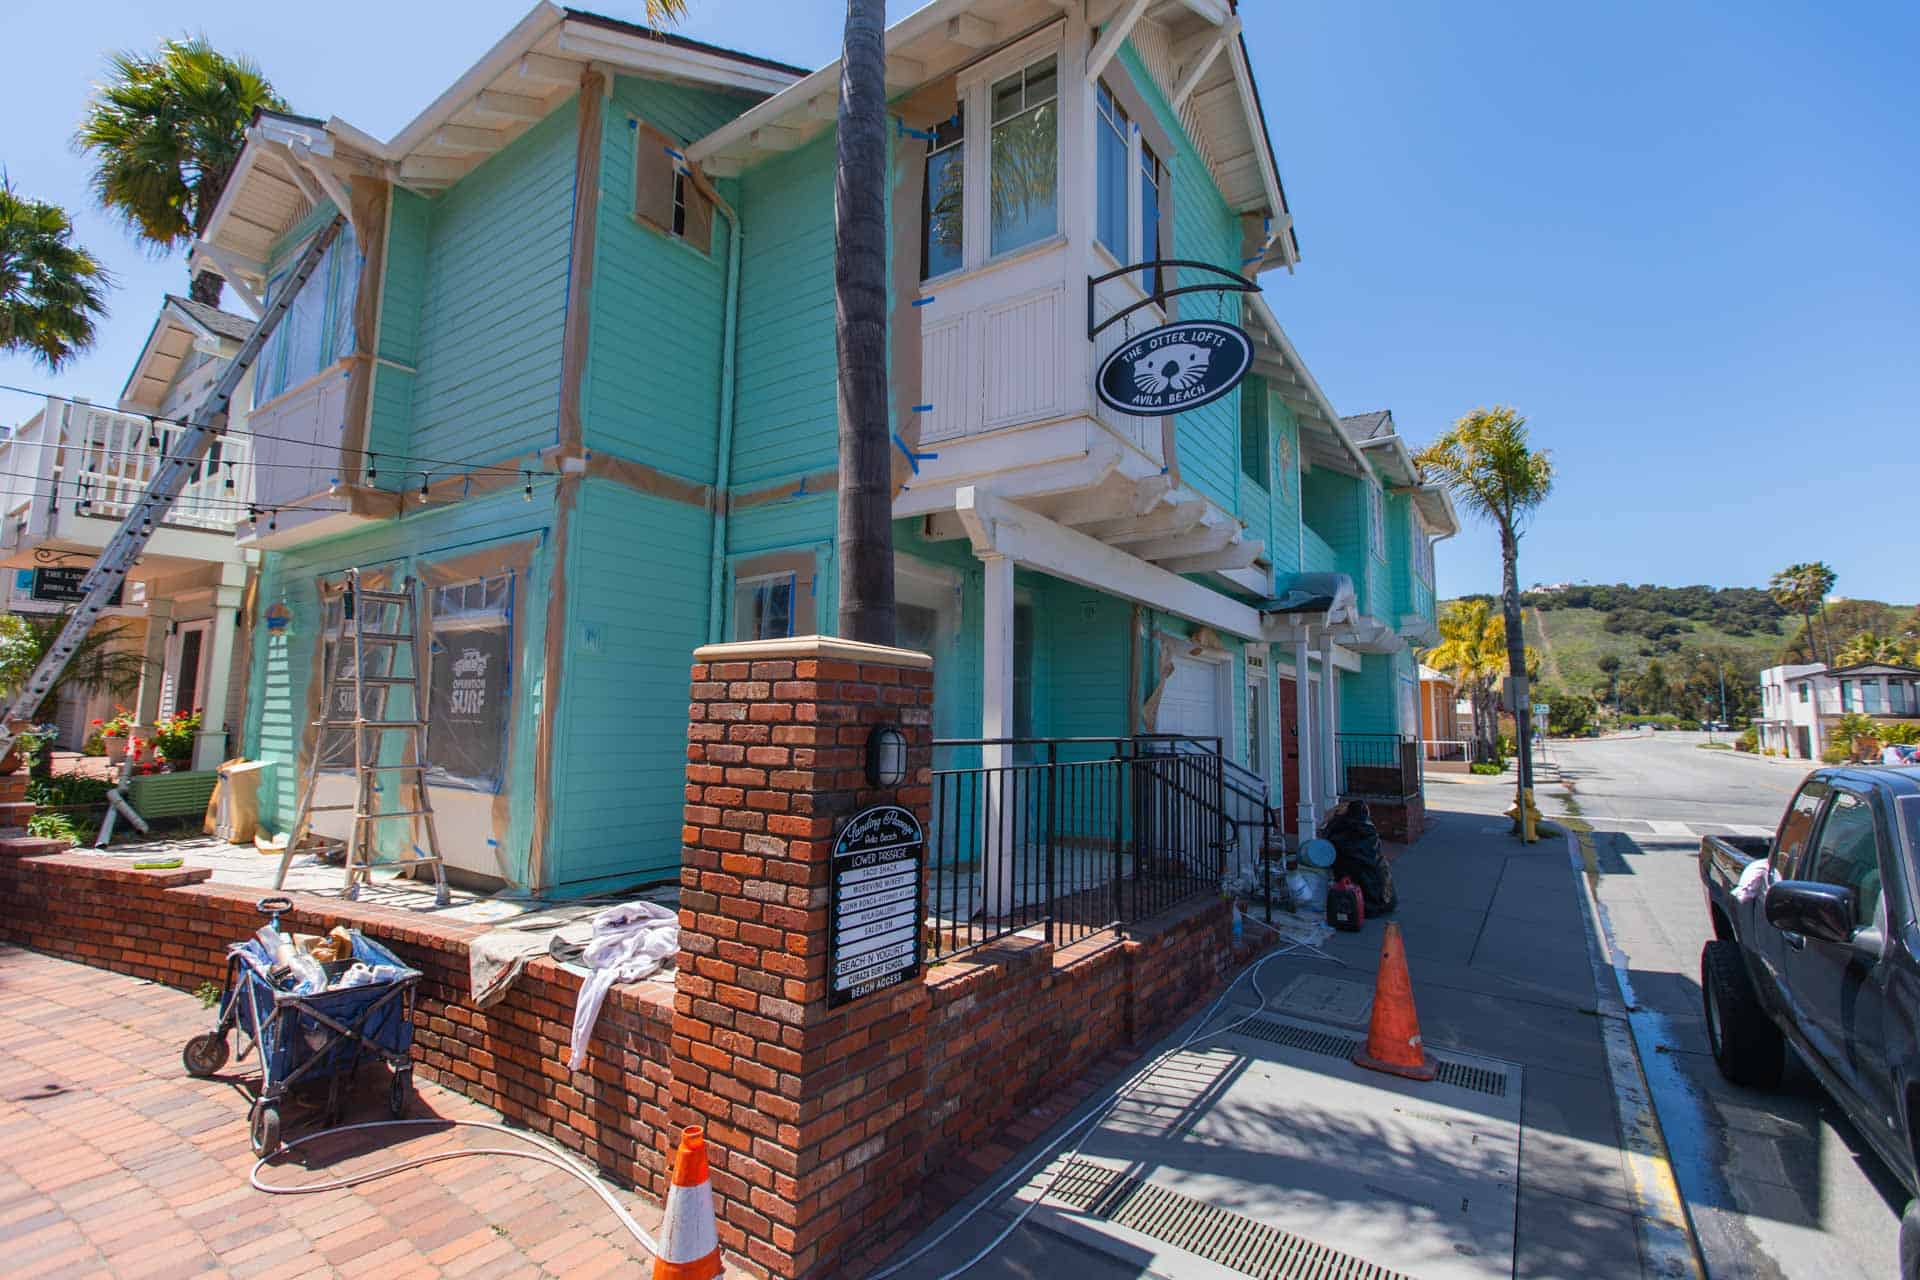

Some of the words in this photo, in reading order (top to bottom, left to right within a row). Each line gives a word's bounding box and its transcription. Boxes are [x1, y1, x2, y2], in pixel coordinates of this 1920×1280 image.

[1122, 344, 1144, 364] THE
[1150, 332, 1186, 349] OTTER
[1191, 331, 1227, 348] LOFTS
[1132, 394, 1162, 405] AVILA
[1168, 384, 1206, 404] BEACH
[450, 690, 486, 714] SURF
[846, 812, 881, 844] Landing
[851, 853, 877, 867] LOWER
[878, 848, 907, 860] PASSAGE
[875, 972, 902, 990] ACCESS
